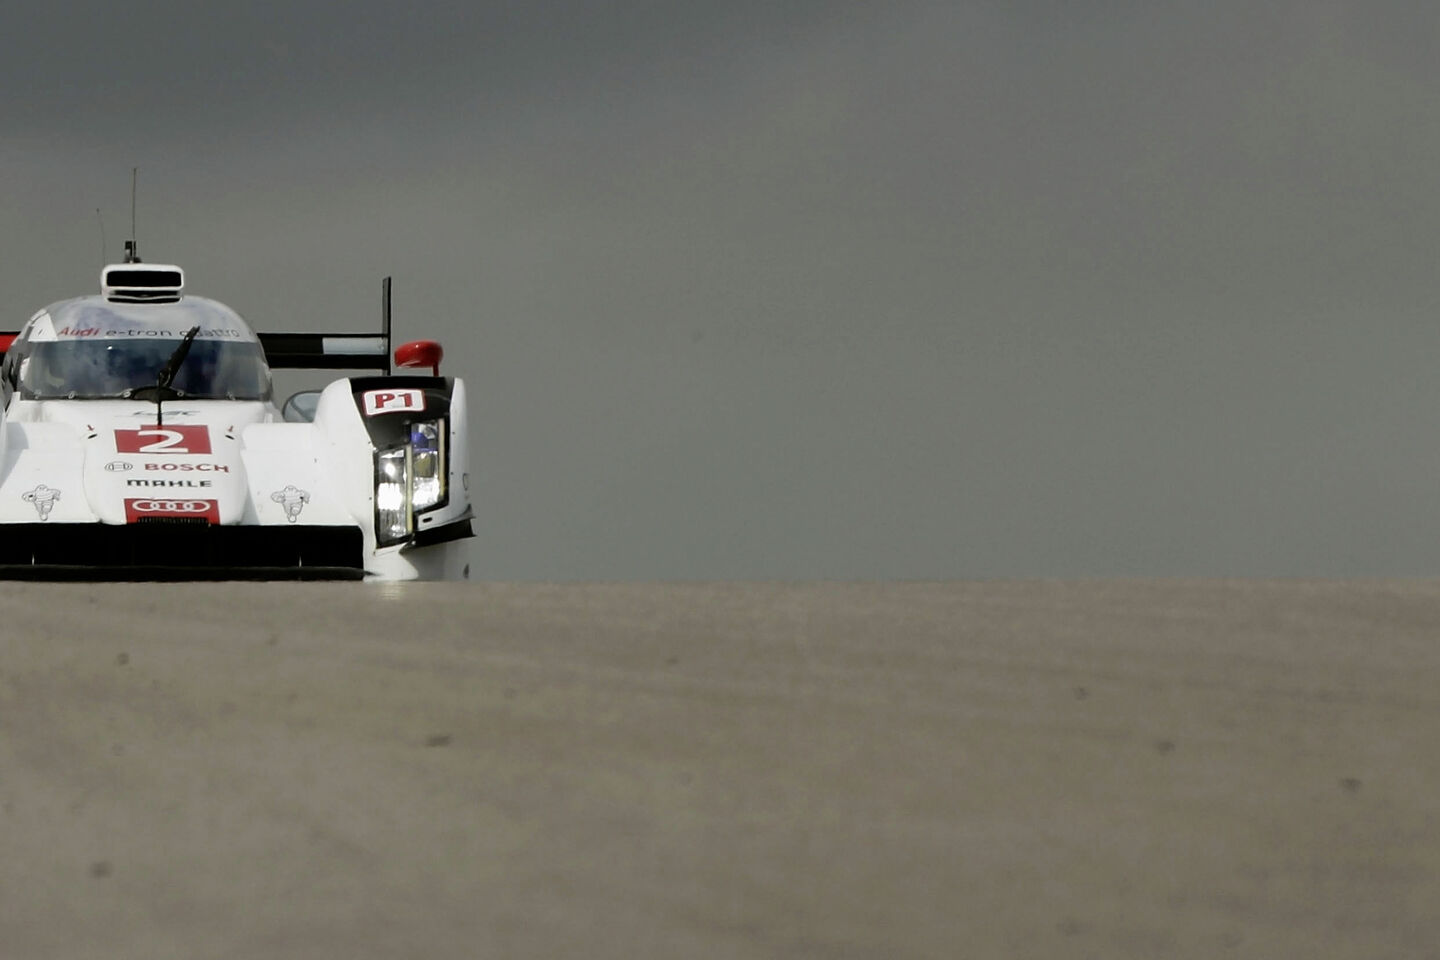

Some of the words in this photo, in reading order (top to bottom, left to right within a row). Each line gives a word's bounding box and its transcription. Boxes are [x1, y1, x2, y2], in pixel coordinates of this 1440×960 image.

[59, 326, 102, 337] Audi
[106, 327, 172, 337] e-tron
[375, 392, 412, 409] P1
[137, 429, 189, 453] 2
[144, 463, 229, 473] BOSCH
